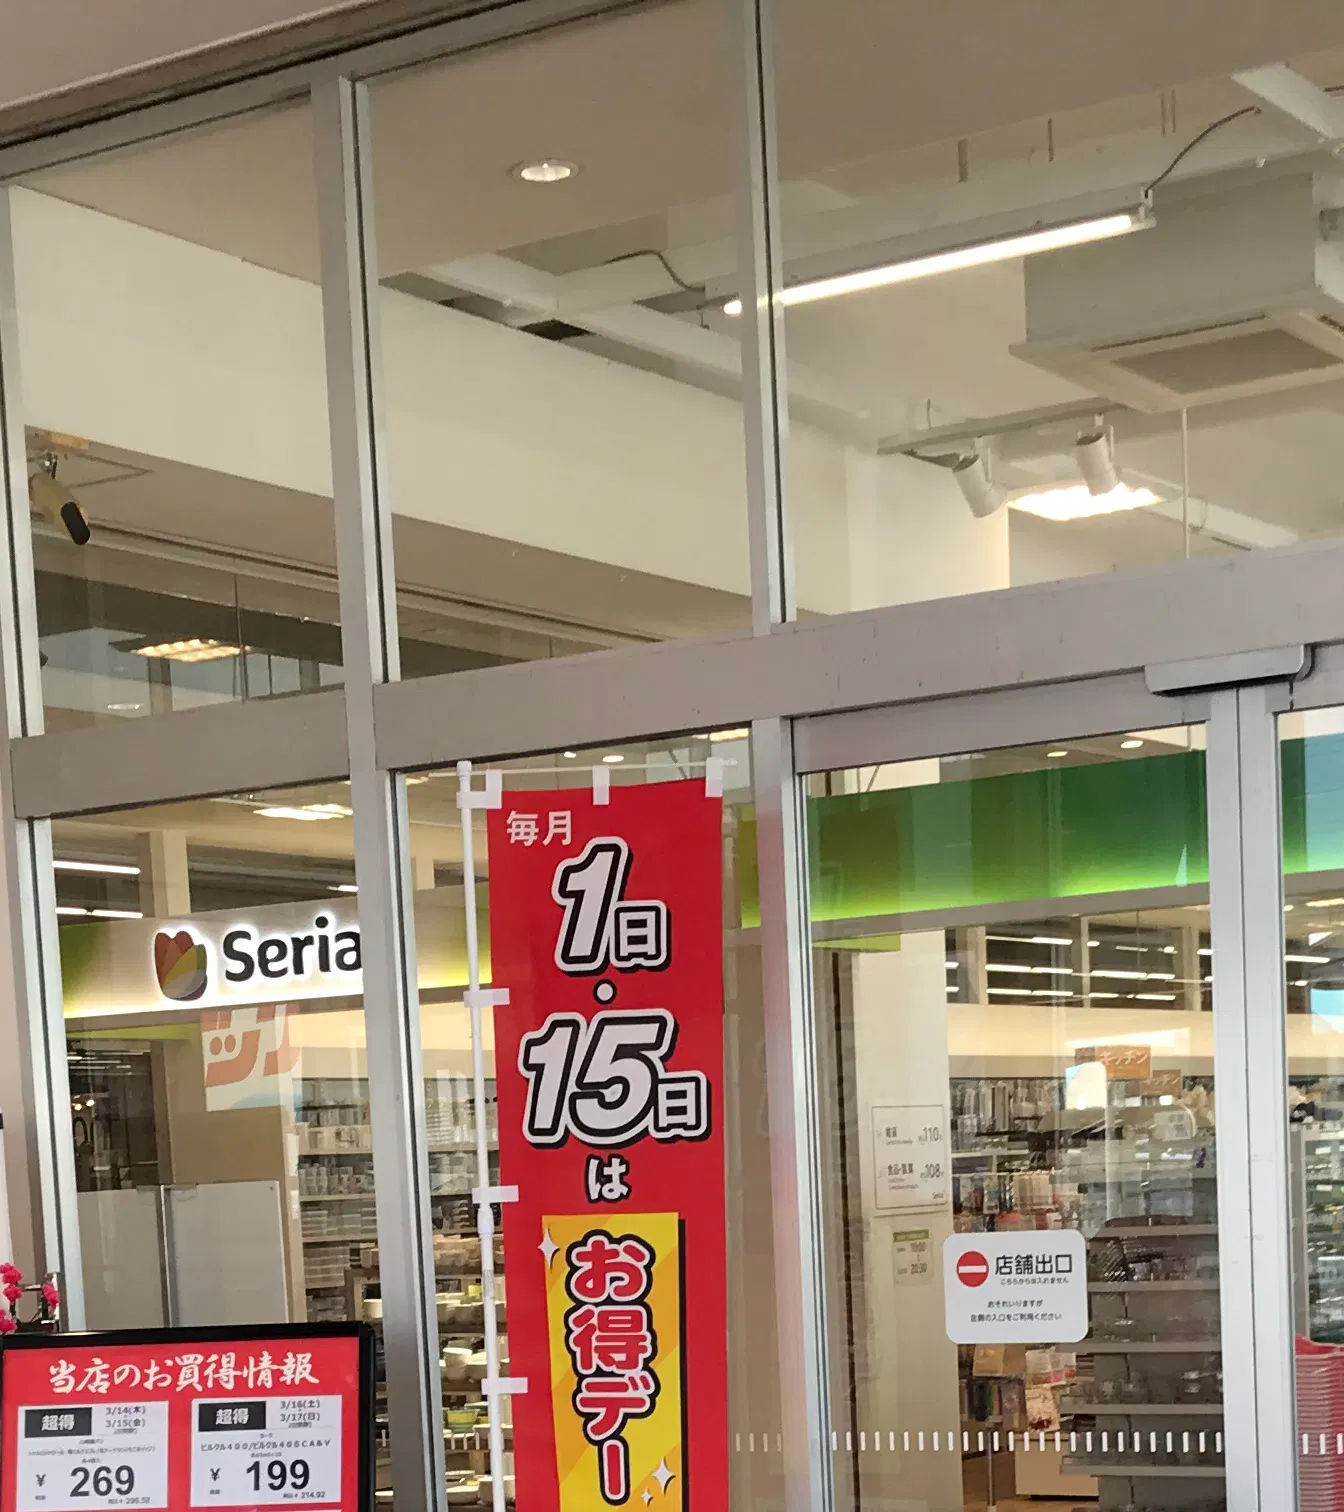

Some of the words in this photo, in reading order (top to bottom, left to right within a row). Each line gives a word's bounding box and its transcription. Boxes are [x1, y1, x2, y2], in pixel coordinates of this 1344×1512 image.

[506, 810, 574, 847] 毎月
[223, 916, 362, 983] Seria
[1099, 1050, 1148, 1065] キッチン
[923, 1127, 939, 1142] 110
[925, 1164, 940, 1178] 108
[995, 1253, 1073, 1276] 店舗出口
[987, 1299, 1044, 1308] おそれいりますが
[48, 1351, 320, 1396] 当店のお買得情報
[565, 1229, 660, 1505] お得デー
[41, 1414, 75, 1431] 超得
[105, 1406, 146, 1415] 3/14(木)
[105, 1418, 146, 1428] 3/15(金)
[216, 1408, 250, 1425] 超得
[280, 1400, 320, 1409] 3/16(土)
[280, 1413, 320, 1422] 3/17(日)
[36, 1474, 46, 1487] ¥
[70, 1465, 135, 1497] 269
[211, 1468, 221, 1481] ¥
[246, 1459, 310, 1491] 199
